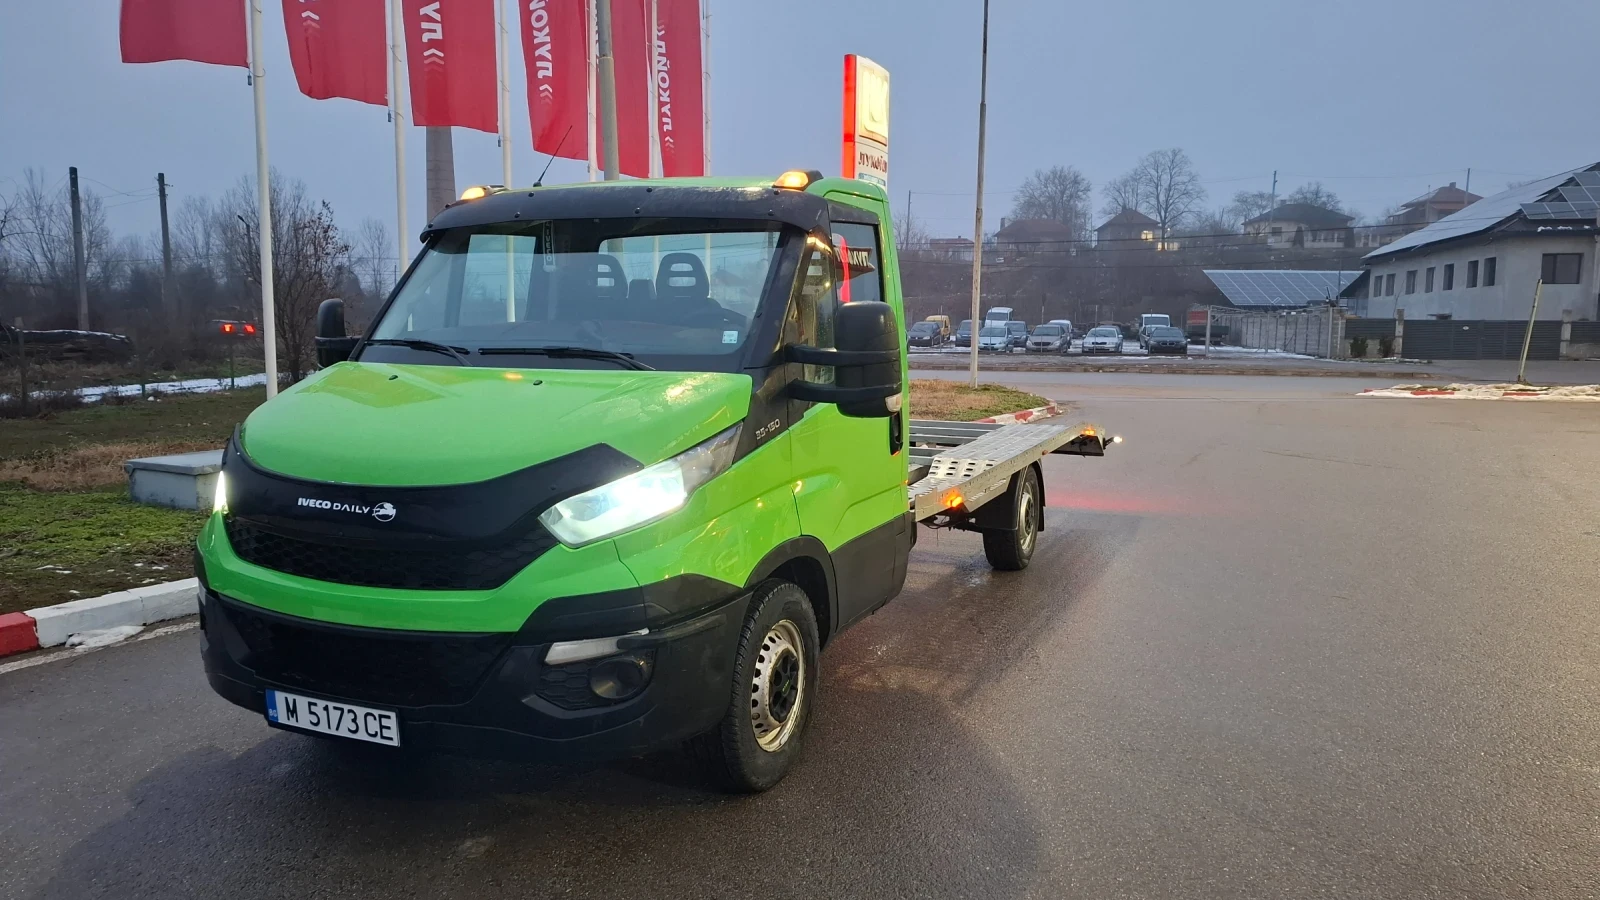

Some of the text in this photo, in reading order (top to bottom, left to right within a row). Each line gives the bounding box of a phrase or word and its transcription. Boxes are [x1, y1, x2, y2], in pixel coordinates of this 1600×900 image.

[755, 418, 781, 440] 35-150
[297, 497, 371, 514] IVECO DAILY
[284, 696, 299, 723] M
